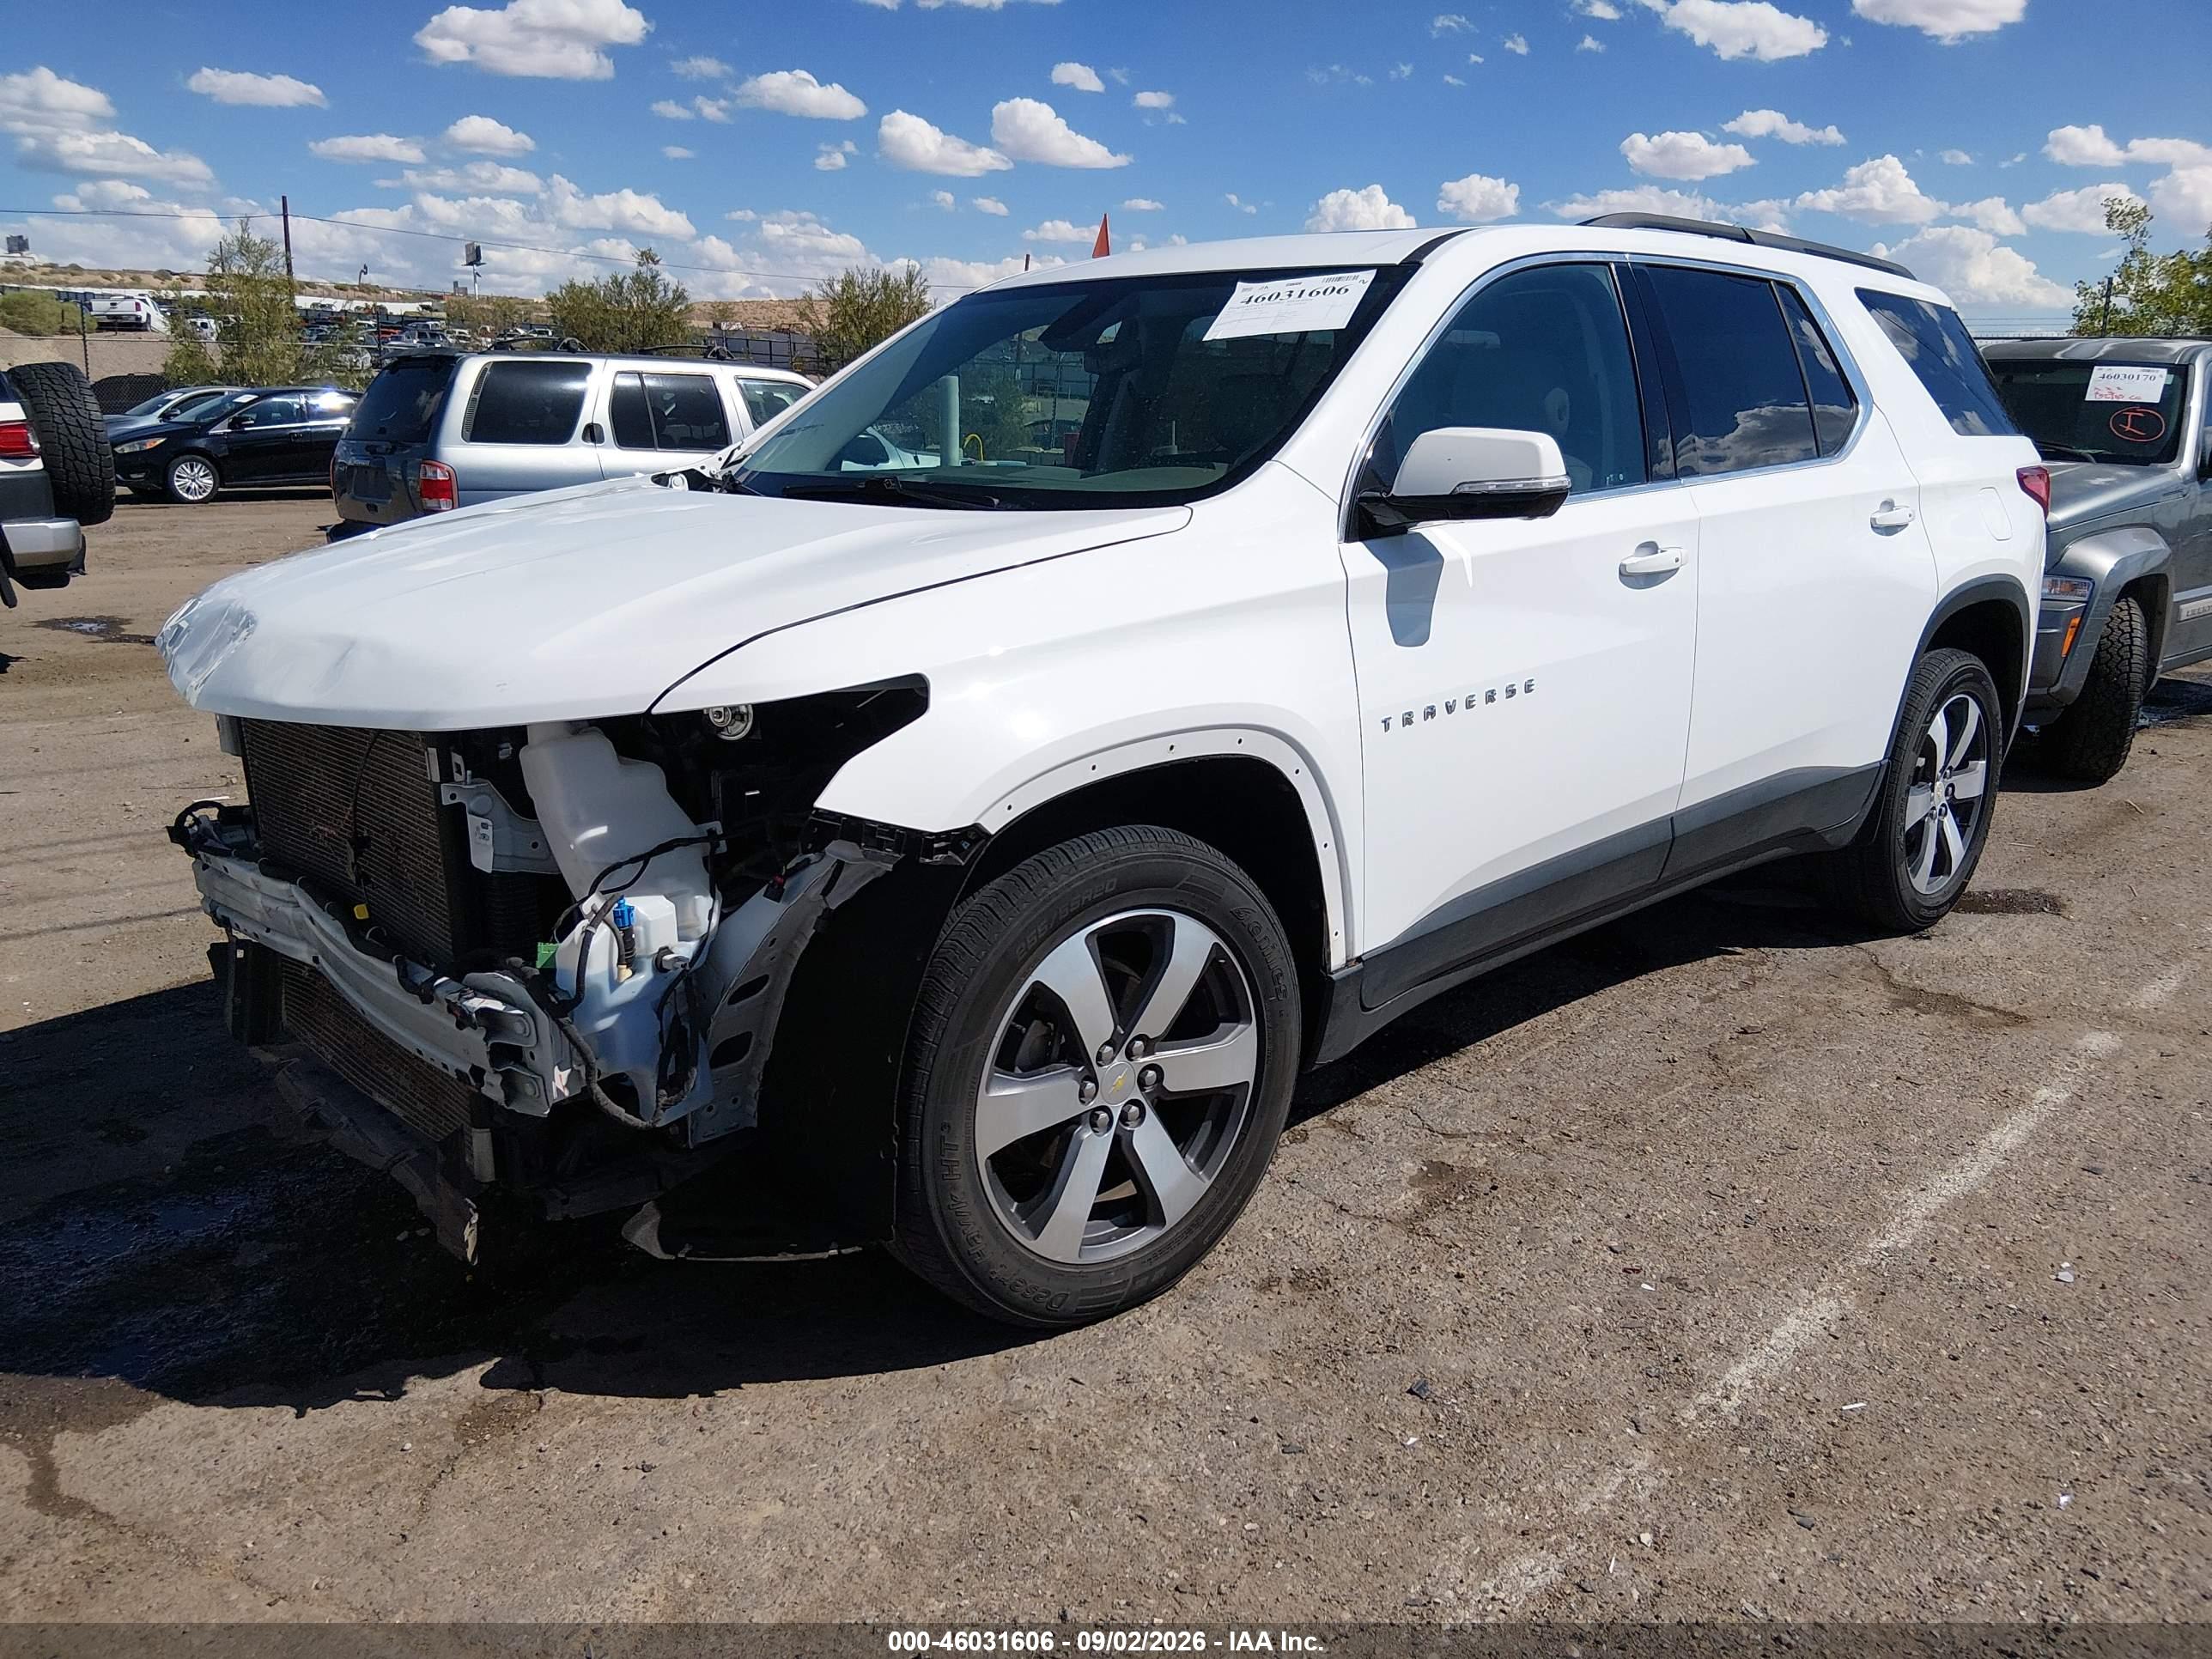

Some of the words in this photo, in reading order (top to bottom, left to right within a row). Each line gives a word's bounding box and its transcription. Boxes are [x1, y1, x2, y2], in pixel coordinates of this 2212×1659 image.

[1240, 284, 1354, 305] 46031606
[2099, 373, 2156, 381] 46030170
[1381, 678, 1534, 732] TRAVERSE
